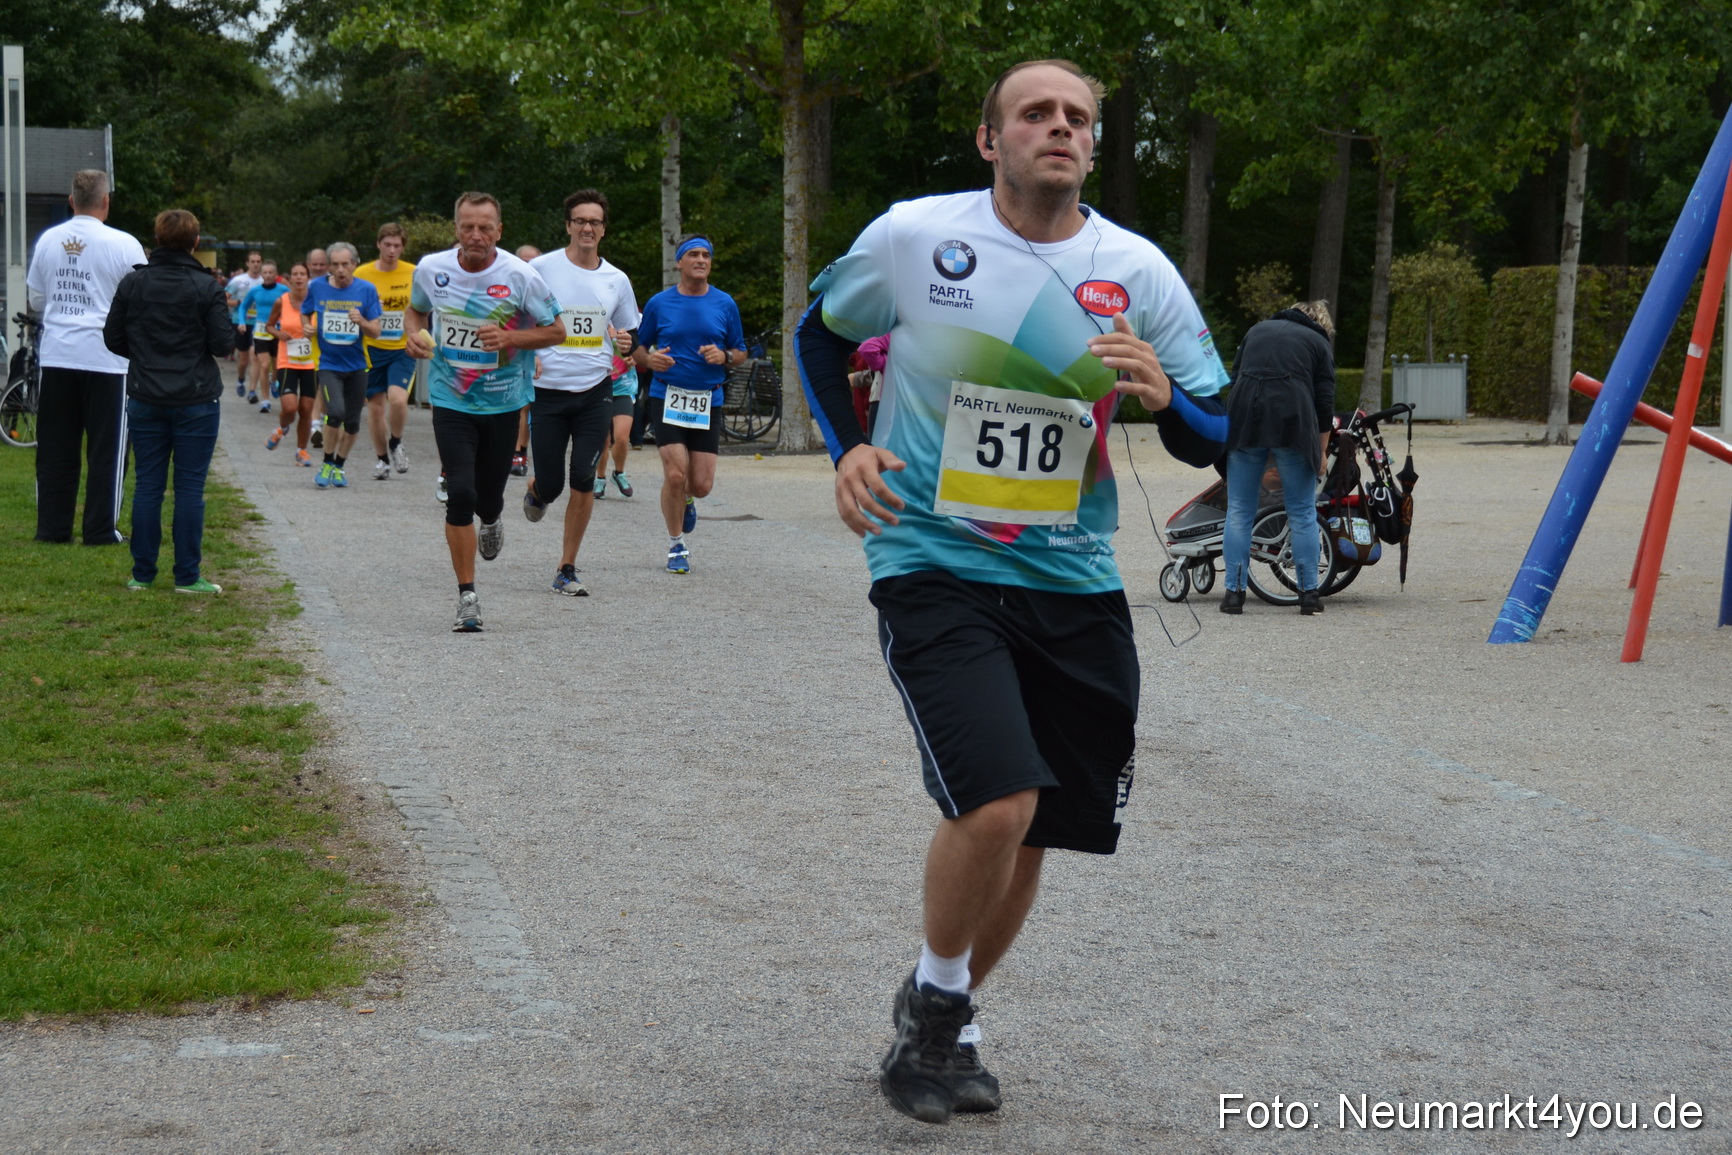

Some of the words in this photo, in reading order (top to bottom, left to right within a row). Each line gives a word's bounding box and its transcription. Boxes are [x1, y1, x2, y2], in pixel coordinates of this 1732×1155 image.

[57, 281, 86, 292] SEINER
[929, 283, 974, 301] PARTL
[929, 295, 973, 310] Neumarkt
[1083, 286, 1124, 308] Hervis
[60, 305, 85, 317] JESUS
[327, 319, 356, 333] 2512
[381, 318, 402, 329] 732
[573, 317, 593, 335] 53
[446, 326, 482, 349] 272
[457, 351, 480, 361] Ulrich
[670, 393, 707, 412] 2149
[954, 394, 1002, 413] PARTL
[1005, 402, 1074, 423] Neumarkt
[976, 419, 1064, 473] 518
